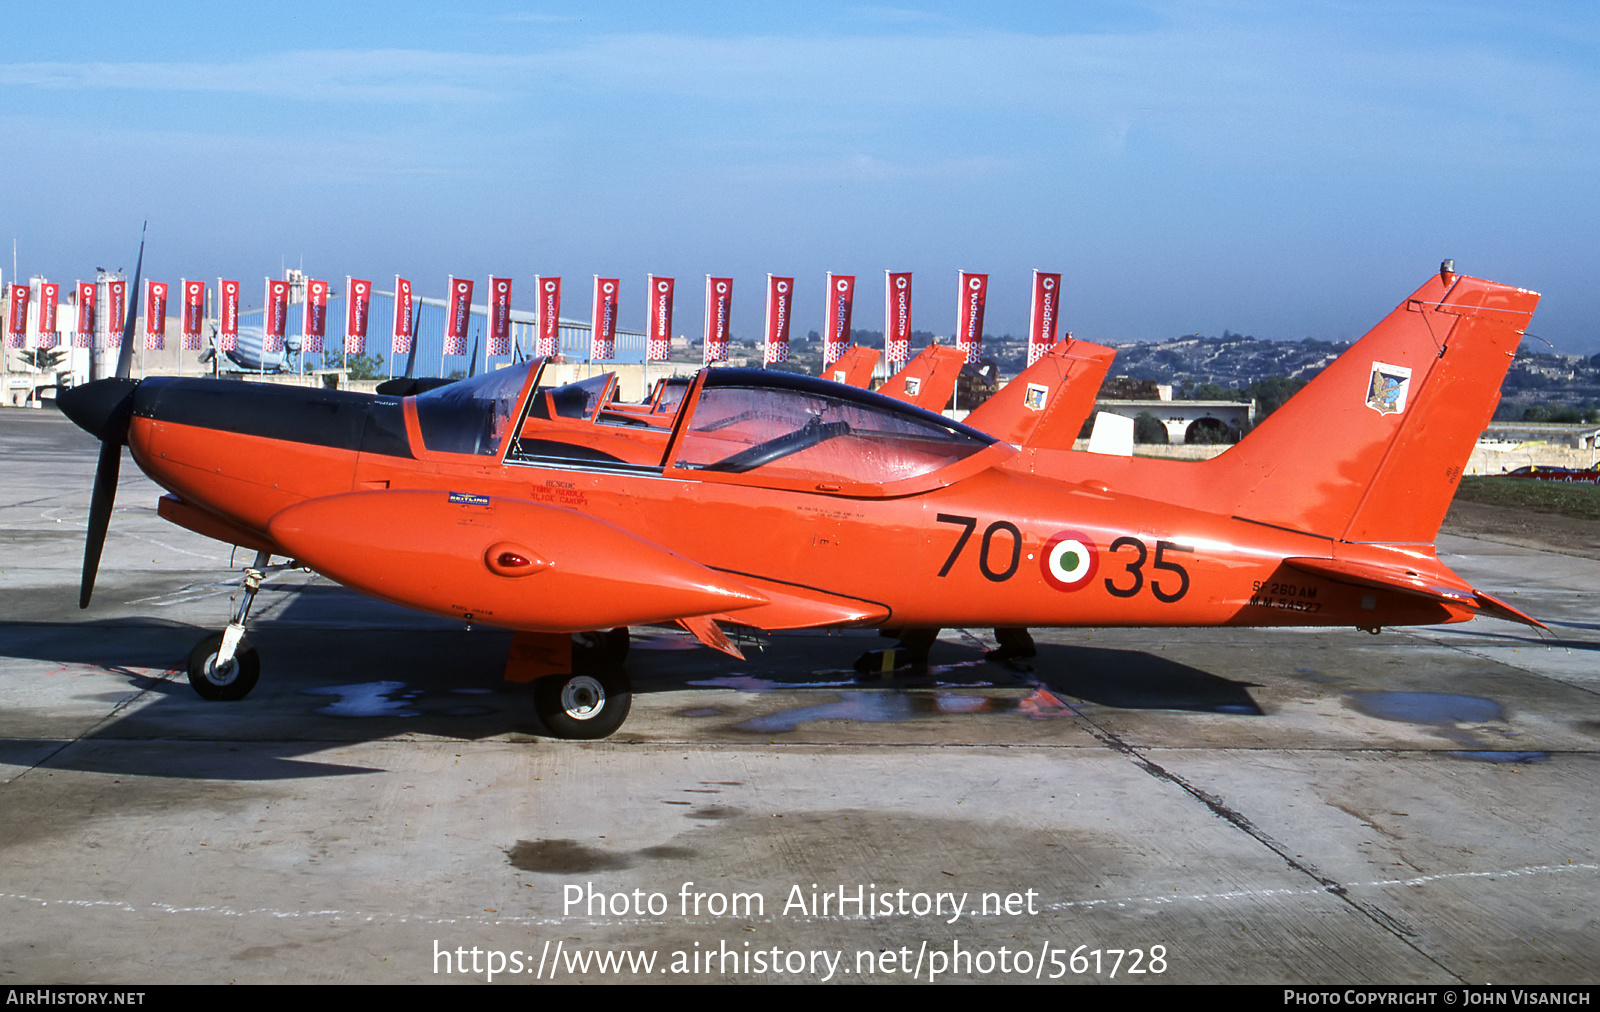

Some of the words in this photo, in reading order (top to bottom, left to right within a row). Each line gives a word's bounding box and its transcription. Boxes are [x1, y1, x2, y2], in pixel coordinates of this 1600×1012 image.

[402, 294, 411, 332] vodafone
[455, 294, 466, 333] vodafone
[497, 294, 506, 333] vodafone
[546, 294, 556, 334] vodafone
[602, 295, 613, 337] vodafone
[658, 294, 667, 336] vodafone
[716, 295, 726, 338] vodafone
[776, 295, 786, 338] vodafone
[836, 294, 846, 338] vodafone
[898, 291, 907, 336] vodafone
[968, 292, 978, 338] vodafone
[1042, 292, 1053, 339] vodafone
[559, 496, 588, 505] CANOPY
[936, 513, 1022, 582] 70
[1104, 536, 1195, 603] 35
[1252, 581, 1267, 592] SF
[1271, 583, 1297, 596] 260
[1299, 587, 1317, 599] AM
[1278, 599, 1322, 613] 54527
